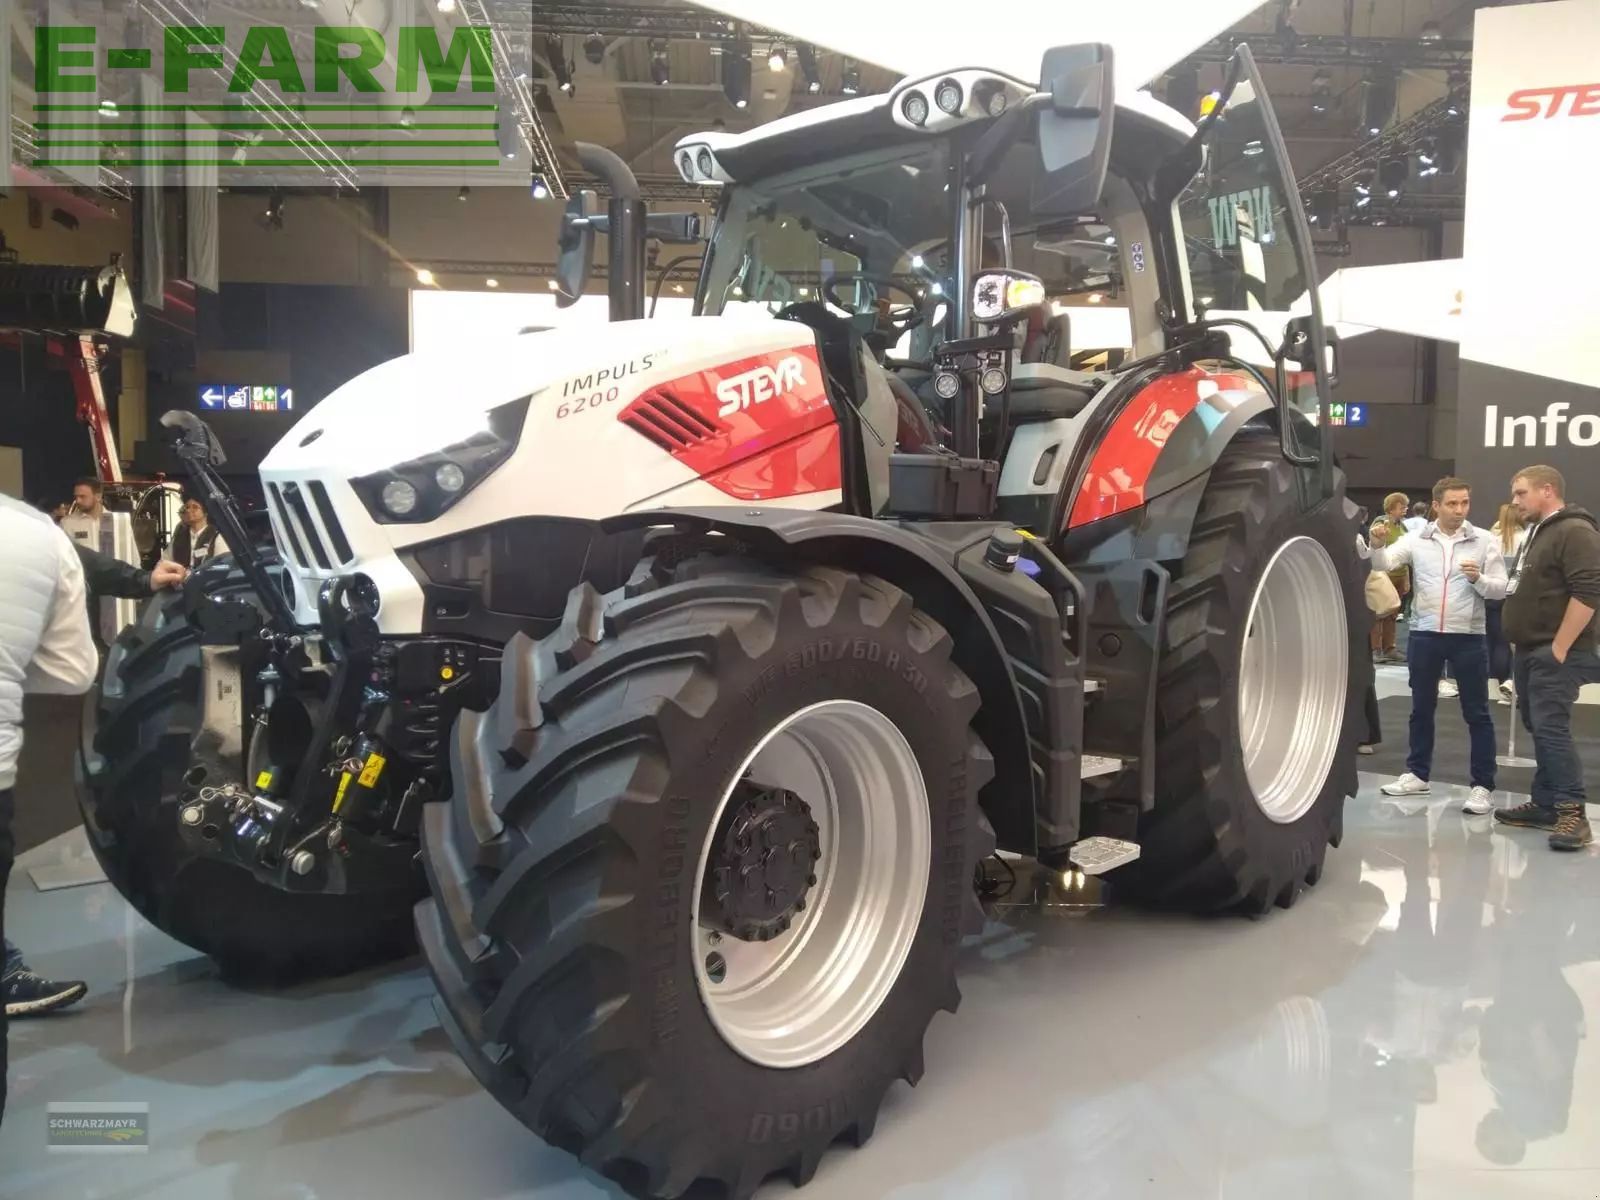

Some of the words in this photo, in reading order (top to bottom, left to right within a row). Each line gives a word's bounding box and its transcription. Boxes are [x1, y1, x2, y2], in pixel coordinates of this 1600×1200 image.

[562, 353, 655, 397] IMPULS
[716, 355, 807, 417] STEYR
[555, 385, 620, 420] 6200
[1350, 406, 1361, 422] 2
[1484, 402, 1600, 448] Info
